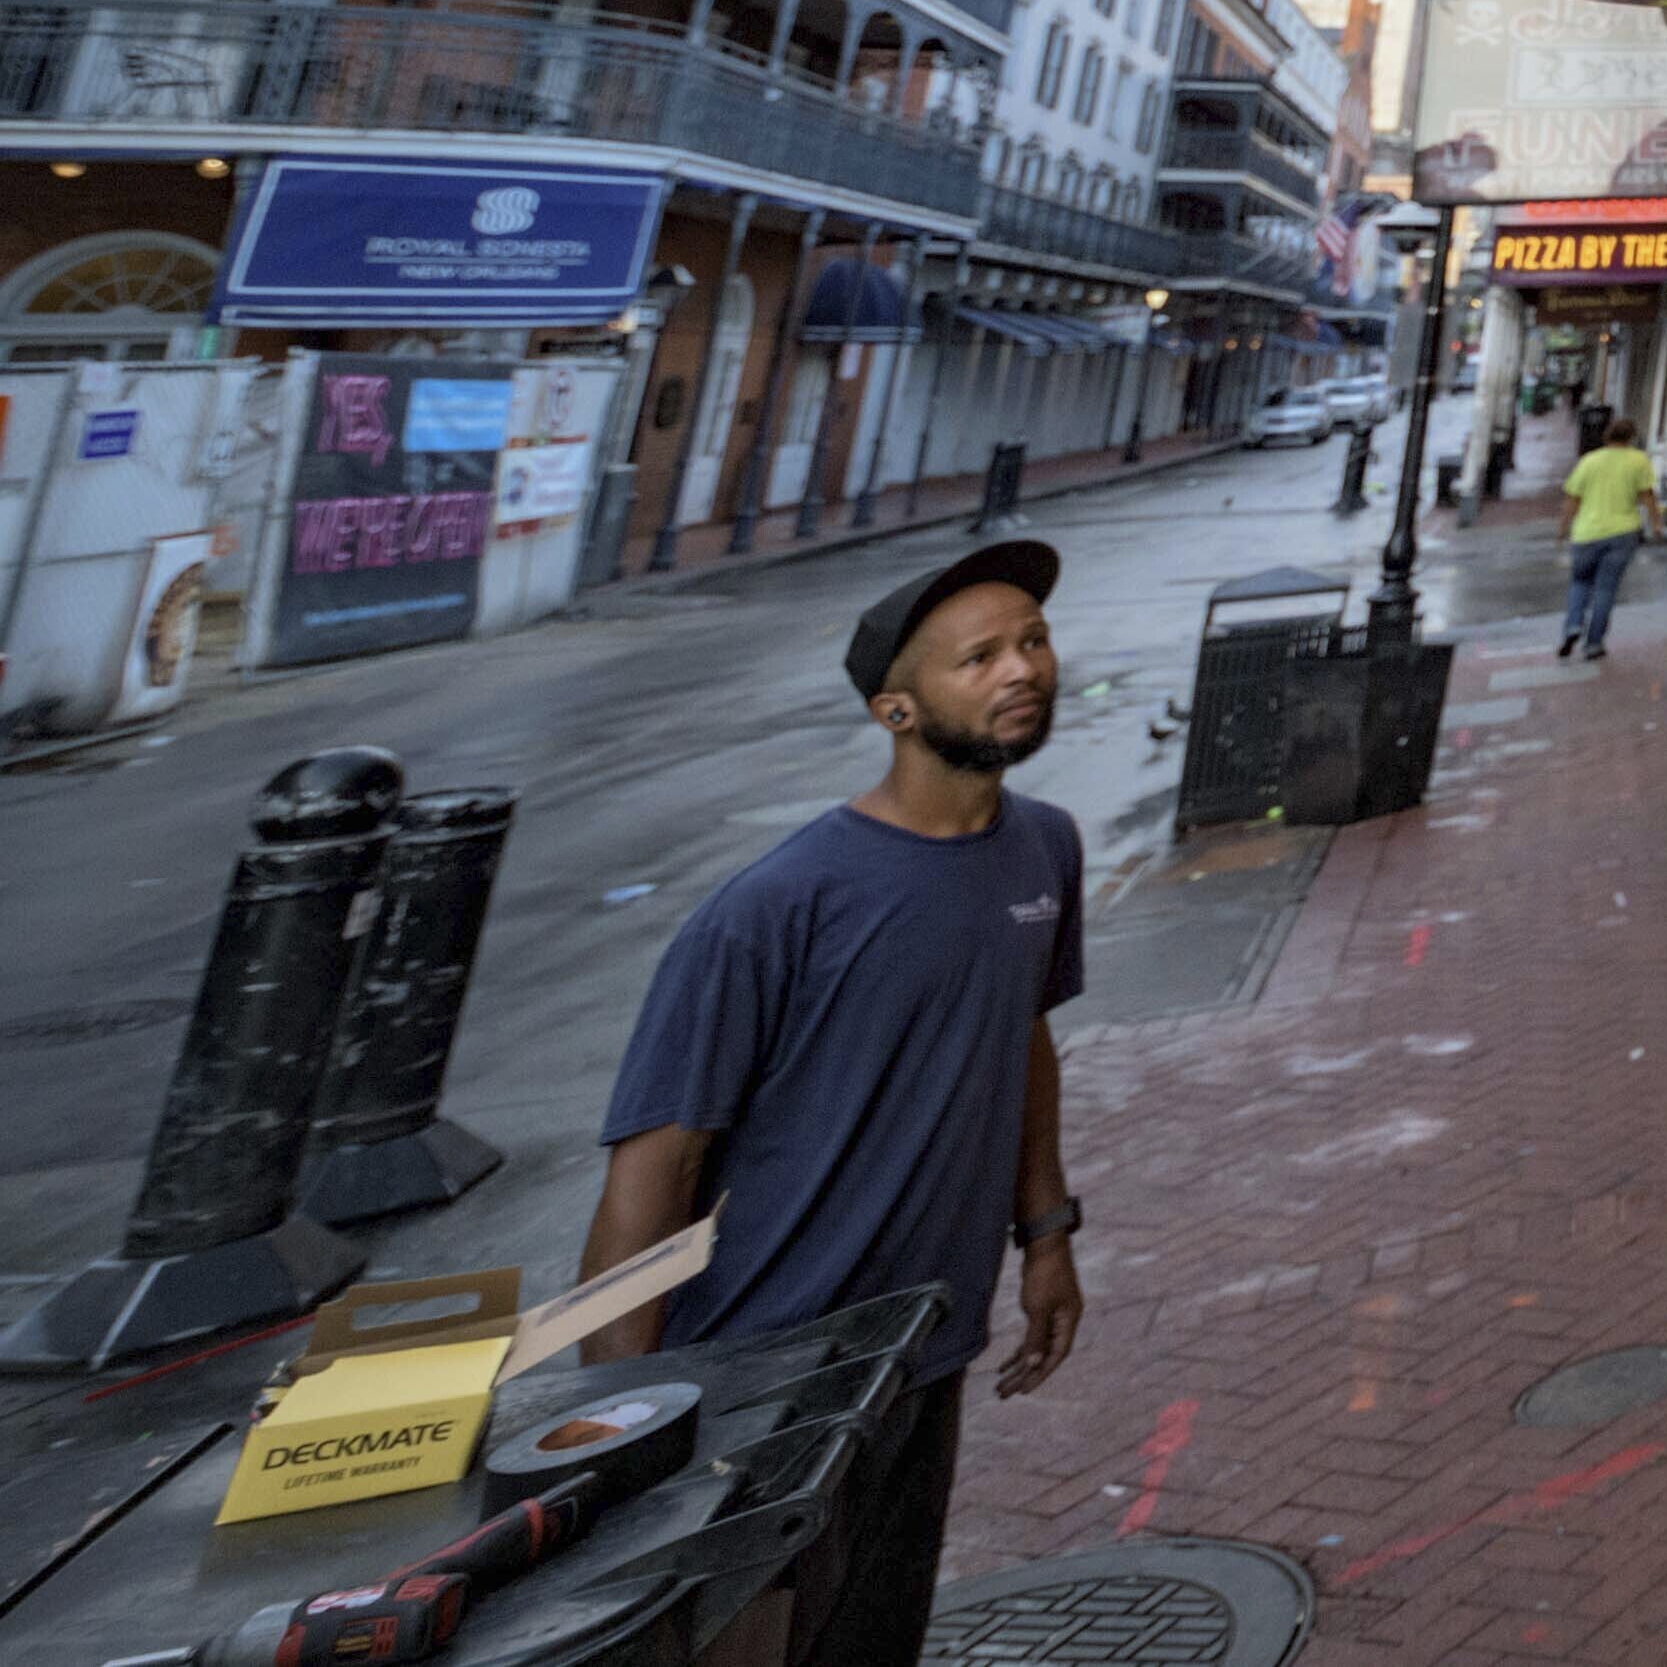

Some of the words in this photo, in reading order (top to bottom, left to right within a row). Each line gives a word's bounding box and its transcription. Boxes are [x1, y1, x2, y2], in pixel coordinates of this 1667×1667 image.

[1495, 235, 1575, 271] PIZZA
[1580, 234, 1617, 269] BY
[262, 1419, 455, 1471] DECKMATE
[283, 1467, 348, 1491] LIFETIME
